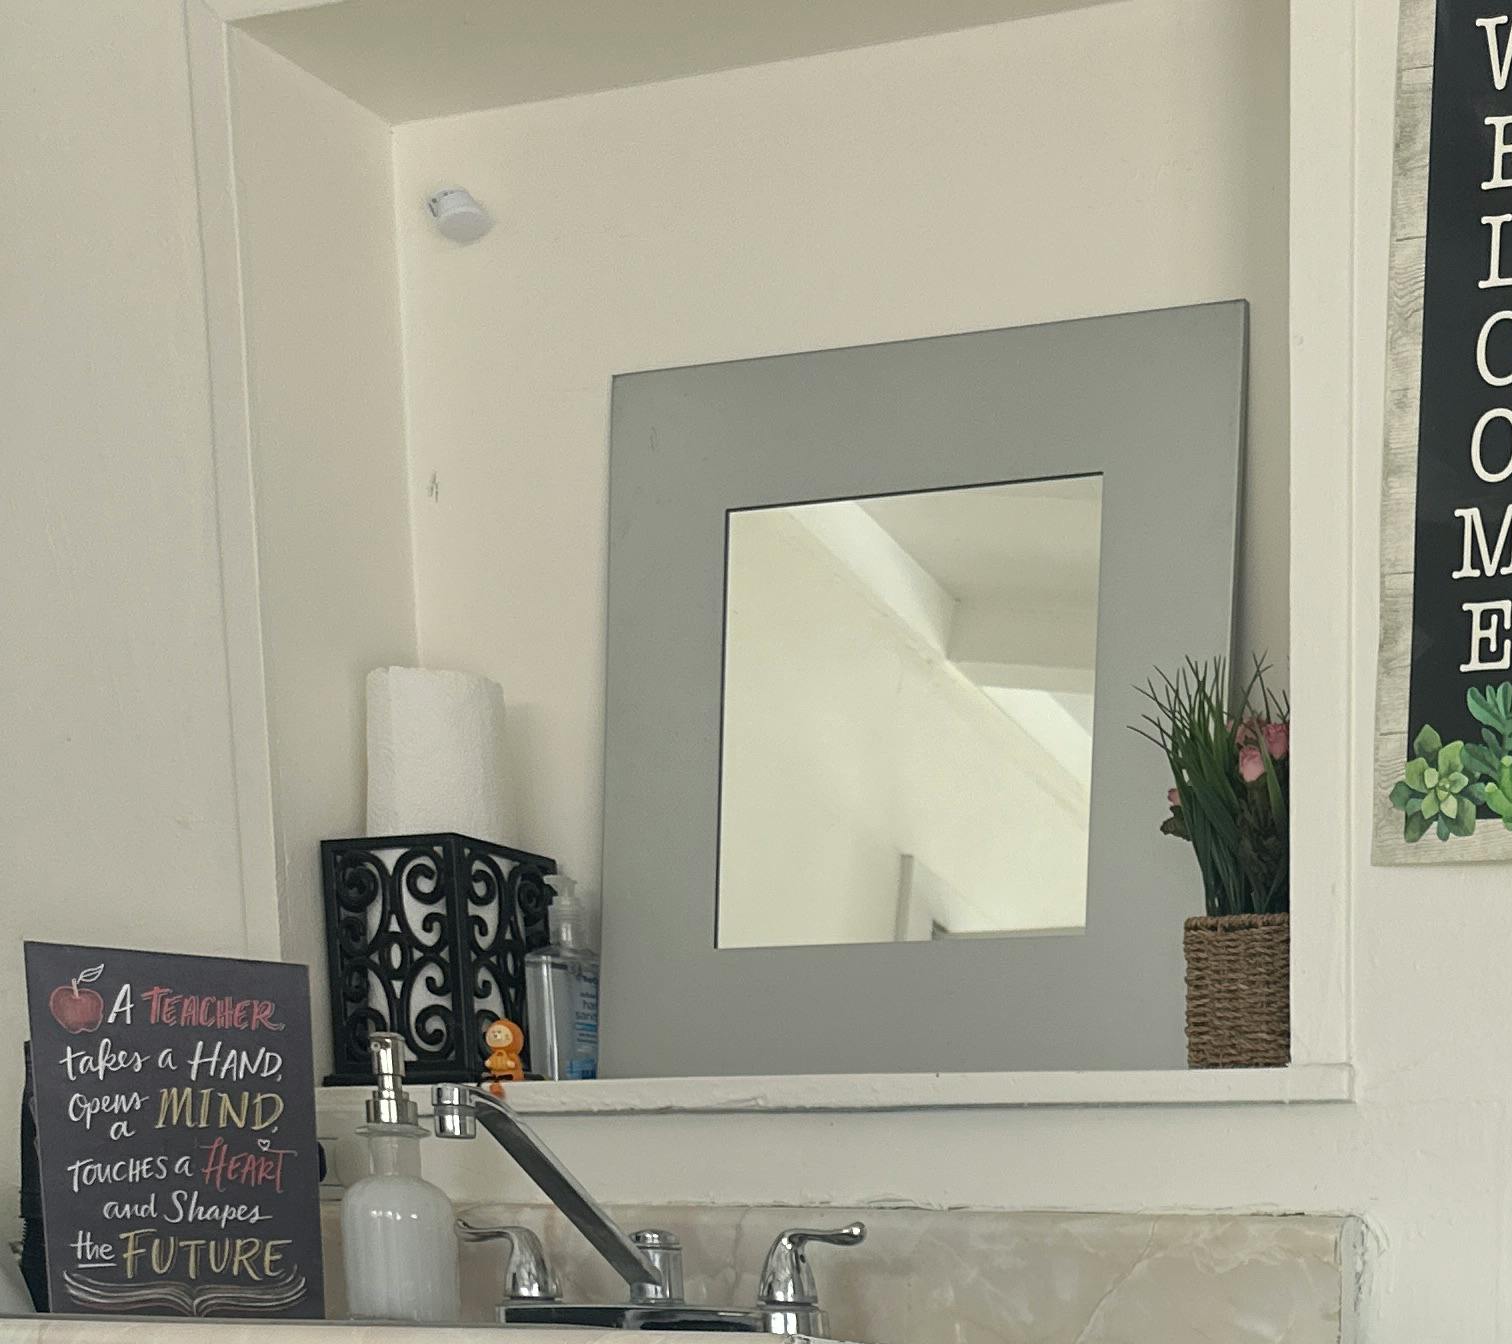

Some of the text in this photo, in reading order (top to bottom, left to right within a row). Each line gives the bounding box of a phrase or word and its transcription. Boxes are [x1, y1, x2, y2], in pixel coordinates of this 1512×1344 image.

[107, 983, 134, 1025] A
[59, 1038, 283, 1082] takes a HAND,
[110, 1121, 136, 1141] a
[154, 1087, 285, 1133] MIND,
[67, 1136, 298, 1194] TOUCHES a HEART
[103, 1190, 273, 1229] and Shapes
[70, 1228, 293, 1281] the FUTURE
